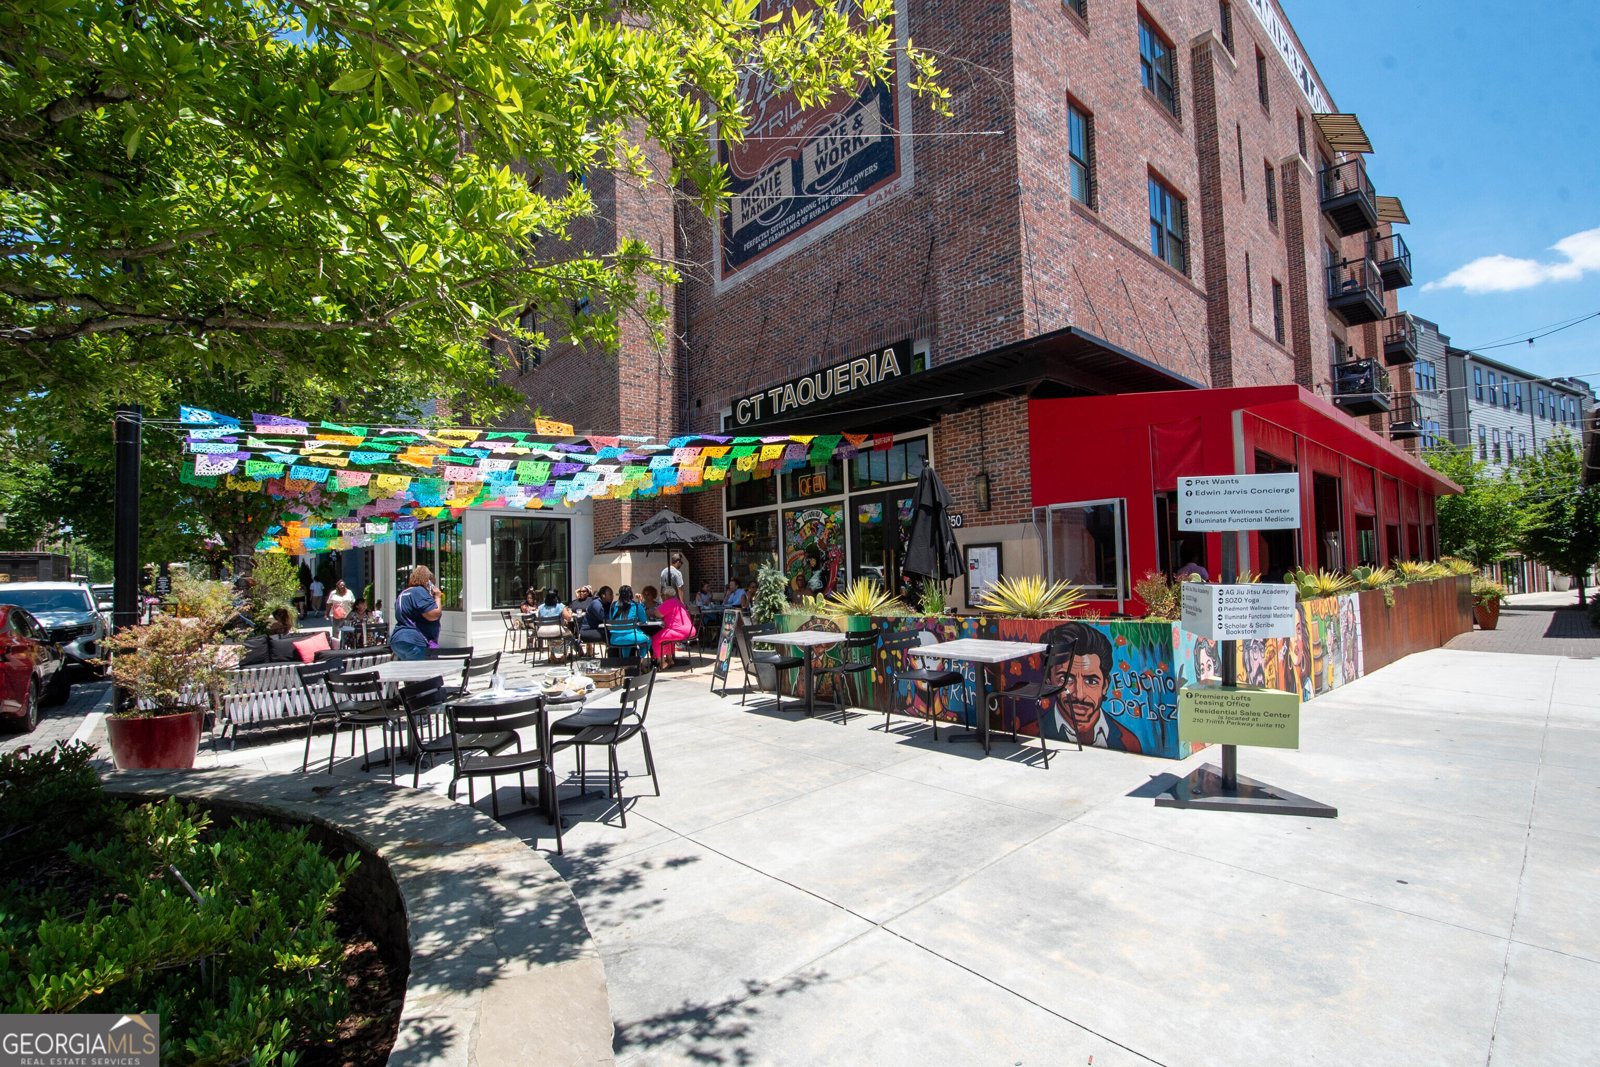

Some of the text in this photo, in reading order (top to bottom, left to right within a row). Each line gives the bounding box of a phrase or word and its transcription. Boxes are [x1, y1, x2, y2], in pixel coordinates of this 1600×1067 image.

[816, 123, 848, 157] LIVE
[852, 113, 863, 130] &
[815, 129, 869, 175] WORK.
[741, 171, 781, 212] MOVIE
[741, 189, 781, 225] MAKING
[743, 162, 878, 252] PERFECTLY SITUATED AMONG THE WILDFLOWERS
[757, 185, 859, 252] AND FARMLANDS OF RURAL GEORGIA
[736, 347, 901, 425] CT TAQUERIA
[1250, 487, 1295, 495] Concierge
[947, 514, 962, 527] 50
[1261, 588, 1289, 596] Academy
[1112, 669, 1176, 696] Eugenio
[1107, 695, 1177, 721] Derbez
[1194, 692, 1229, 701] Premiere
[1194, 699, 1224, 707] Leasing
[1194, 707, 1238, 715] Residential
[1239, 709, 1261, 717] Sales
[1226, 720, 1255, 728] Parkway
